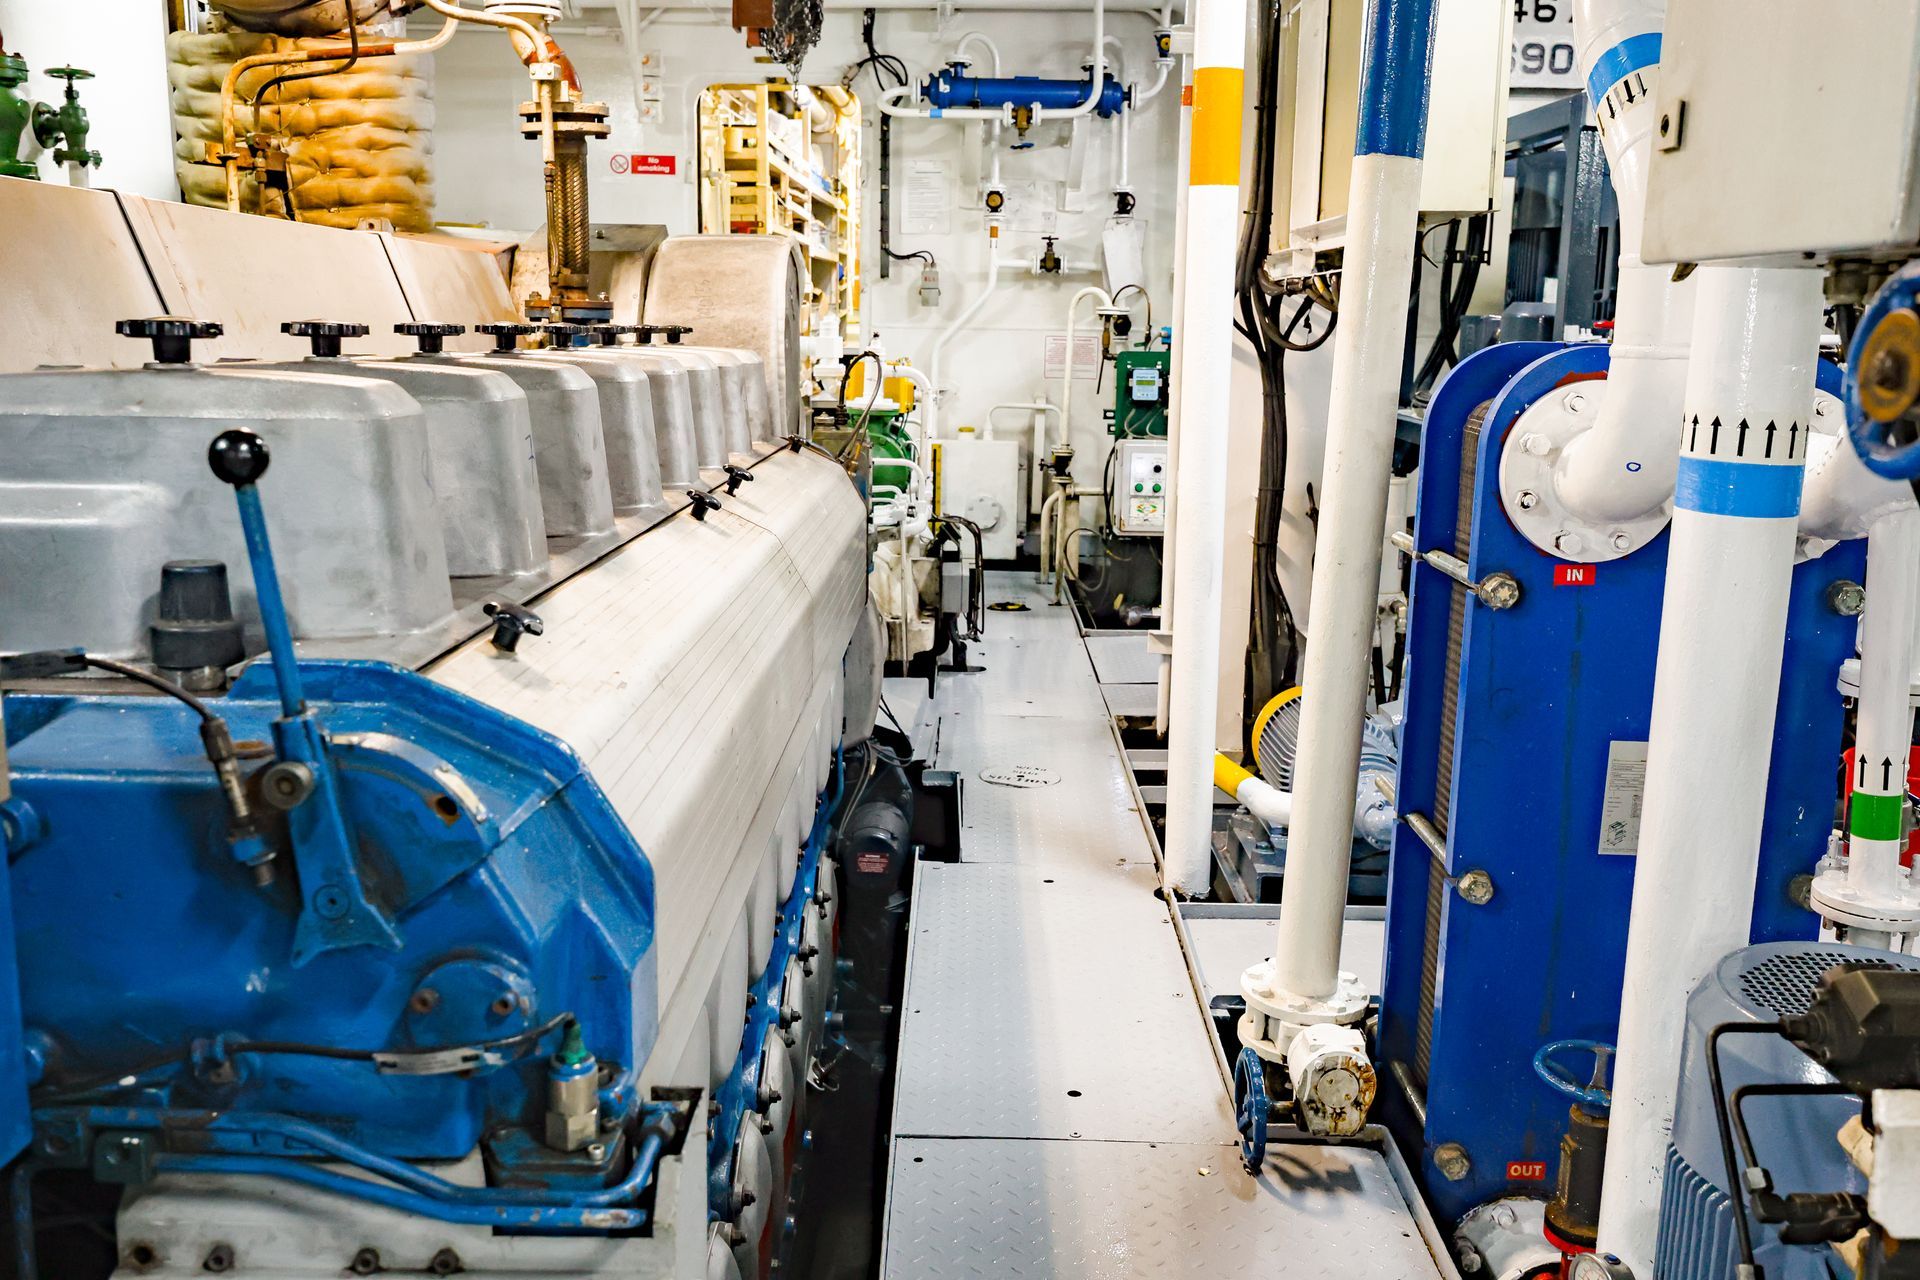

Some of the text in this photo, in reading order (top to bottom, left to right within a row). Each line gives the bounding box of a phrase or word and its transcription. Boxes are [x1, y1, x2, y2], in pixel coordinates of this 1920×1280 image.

[1511, 42, 1574, 74] 90
[637, 165, 670, 173] smoking
[1566, 568, 1583, 581] IN
[1510, 1165, 1542, 1176] OUT
